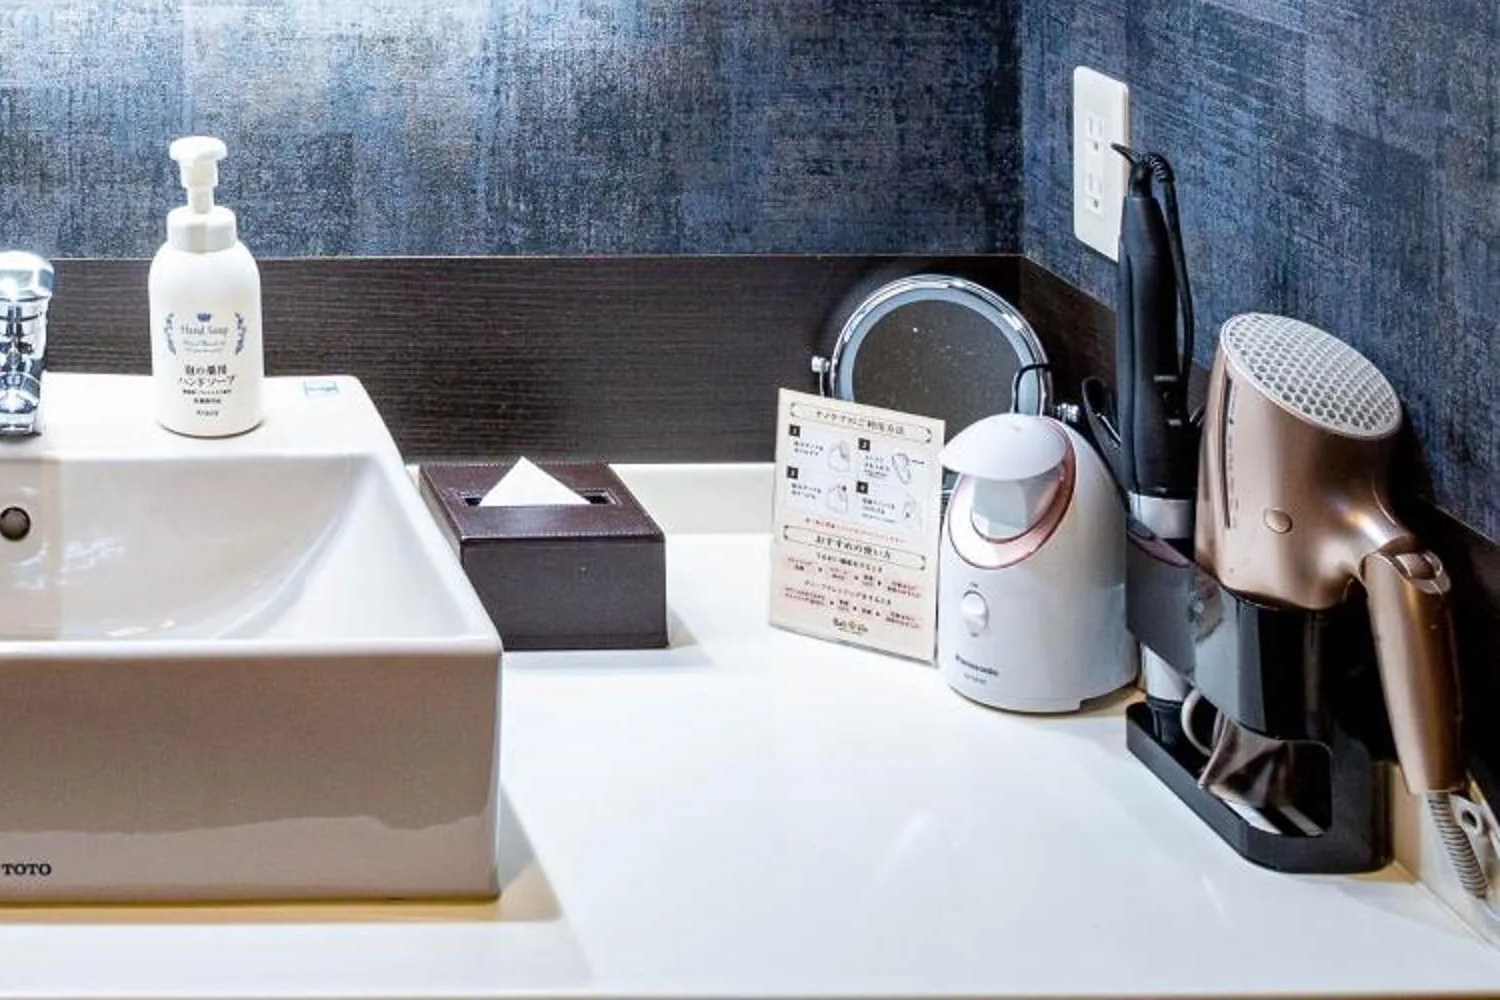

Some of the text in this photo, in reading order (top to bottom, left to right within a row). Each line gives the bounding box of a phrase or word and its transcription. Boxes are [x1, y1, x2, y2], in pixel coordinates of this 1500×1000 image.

[181, 325, 228, 337] Hand Soap
[179, 374, 235, 388] ハンドソープ
[1, 863, 52, 876] TOTO
